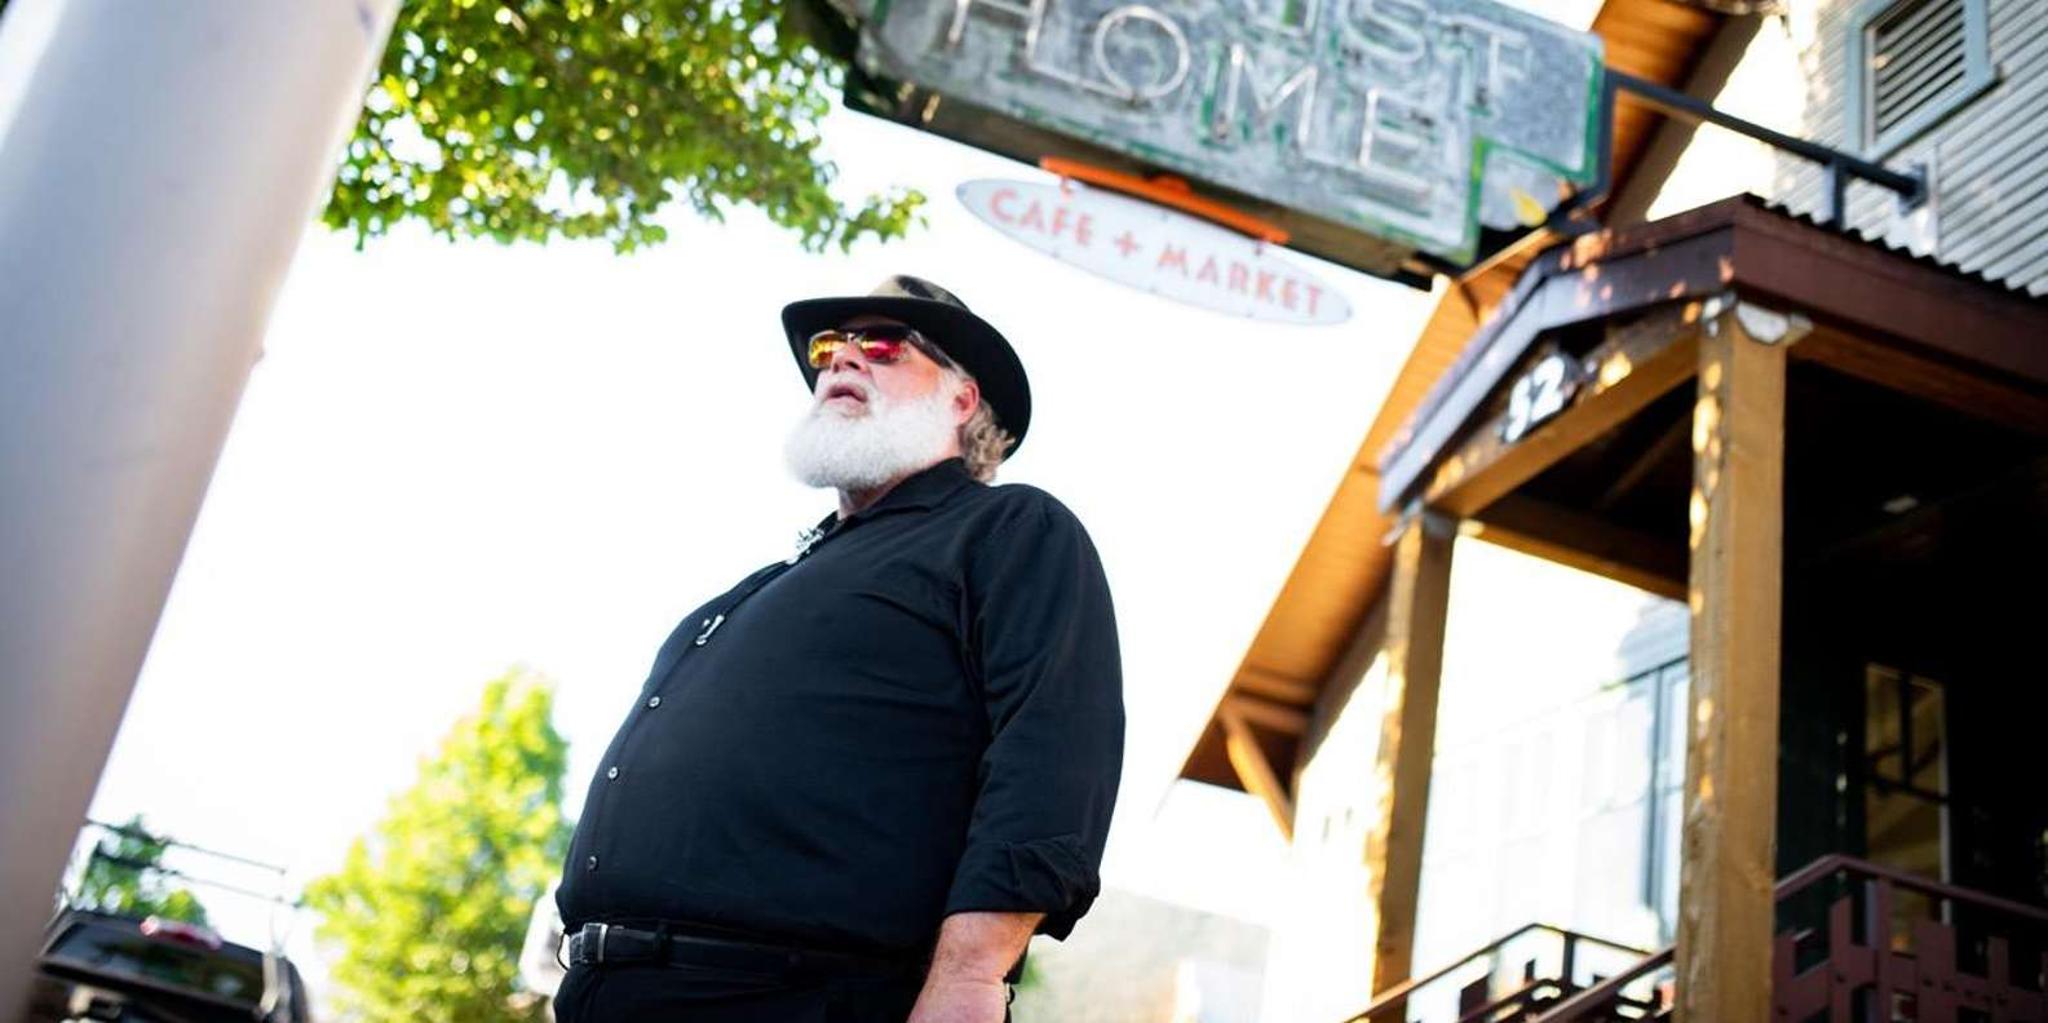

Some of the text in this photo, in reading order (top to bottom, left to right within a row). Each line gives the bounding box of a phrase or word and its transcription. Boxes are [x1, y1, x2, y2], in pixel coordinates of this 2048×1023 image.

[945, 0, 1437, 197] HOME
[987, 187, 1094, 247] CAFE
[1156, 242, 1324, 318] MARKET
